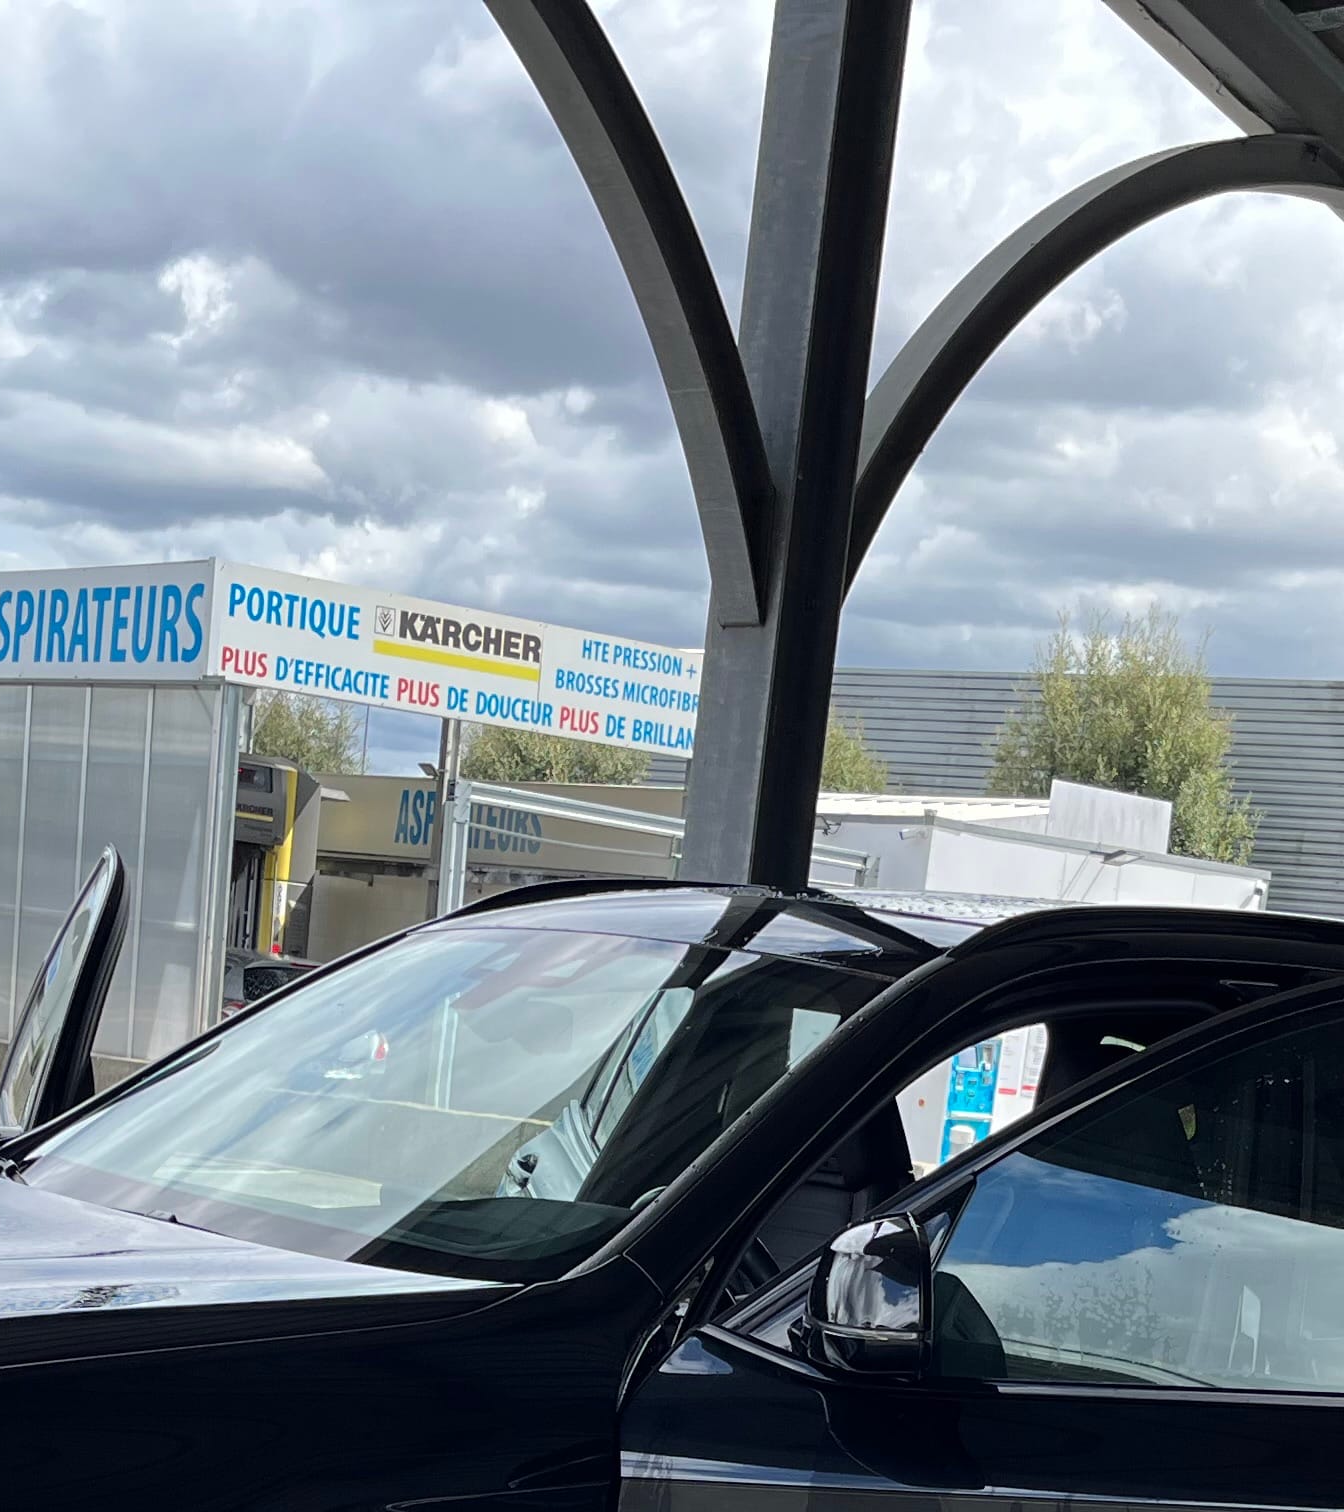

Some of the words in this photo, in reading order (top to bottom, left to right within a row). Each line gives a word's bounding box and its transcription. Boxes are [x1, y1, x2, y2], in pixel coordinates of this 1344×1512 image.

[229, 583, 361, 640] PORTIQUE
[399, 610, 541, 664] KÄRCHER
[556, 669, 619, 699] BROSSES
[582, 638, 609, 663] HTE
[613, 645, 683, 677] PRESSION
[221, 646, 267, 678] PLUS
[275, 656, 390, 699] D'EFFICACITE
[396, 678, 440, 707] PLUS
[447, 686, 469, 712] DE
[475, 691, 553, 727] DOUCEUR
[559, 706, 599, 734] PLUS
[606, 714, 626, 739] DE
